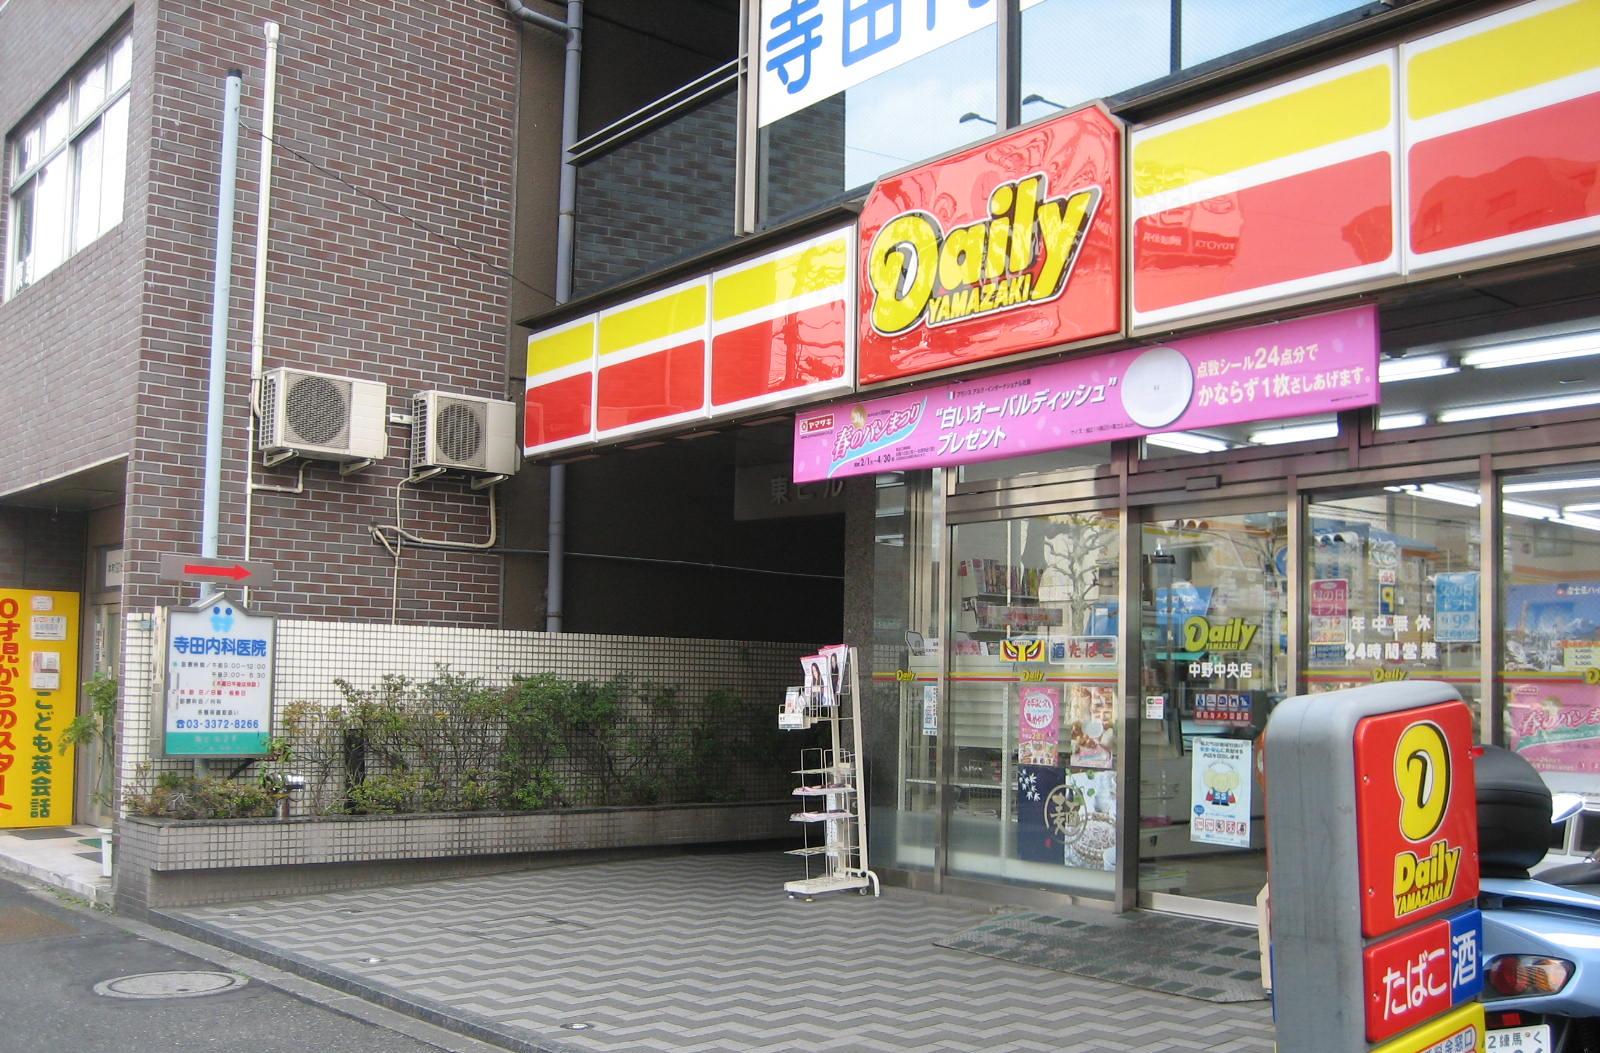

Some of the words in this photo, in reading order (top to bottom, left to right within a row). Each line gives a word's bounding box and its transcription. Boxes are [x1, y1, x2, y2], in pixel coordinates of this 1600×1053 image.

[766, 0, 990, 94] 寺田
[869, 173, 1098, 334] Daily
[929, 273, 1033, 325] YAMAZAKI
[1196, 343, 1320, 379] 点数シール24点分で
[1198, 366, 1371, 407] かならず1枚さしあげます。
[831, 401, 922, 462] 春のパンまつり
[937, 426, 1007, 457] プレゼント
[1183, 615, 1258, 652] Daily
[1351, 614, 1432, 633] 年中無休
[173, 635, 267, 658] 寺田内科医院
[1068, 640, 1114, 659] たばこ
[1344, 642, 1437, 660] 24時間営業
[1188, 661, 1253, 679] 中野中央店
[30, 690, 54, 819] こども英会話
[1395, 840, 1461, 899] Daily
[1395, 882, 1445, 917] YAMAZAKI
[1382, 948, 1447, 1021] たばこ
[1452, 929, 1477, 989] 酒
